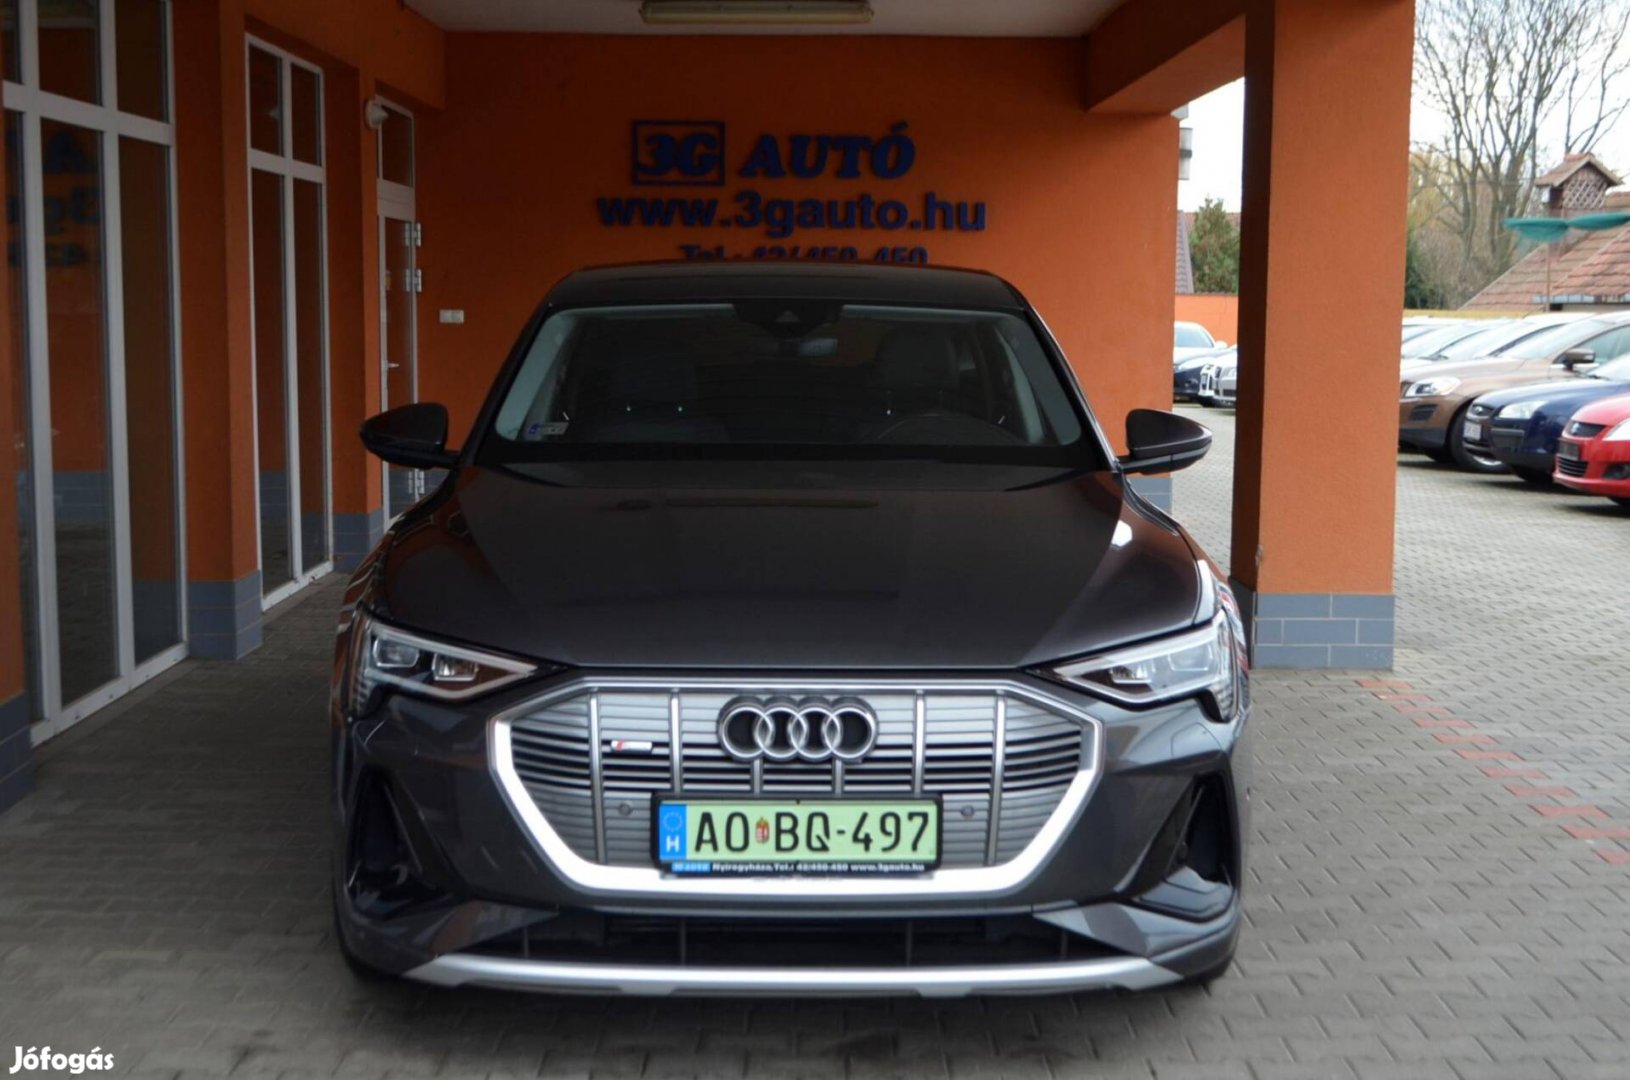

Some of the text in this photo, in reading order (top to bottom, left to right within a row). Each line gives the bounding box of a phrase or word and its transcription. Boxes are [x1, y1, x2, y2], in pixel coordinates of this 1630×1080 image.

[637, 121, 915, 179] 3G AUTÓ
[597, 190, 986, 239] www.3gauto.hu
[666, 836, 680, 852] H
[694, 811, 929, 852] AO BQ-497
